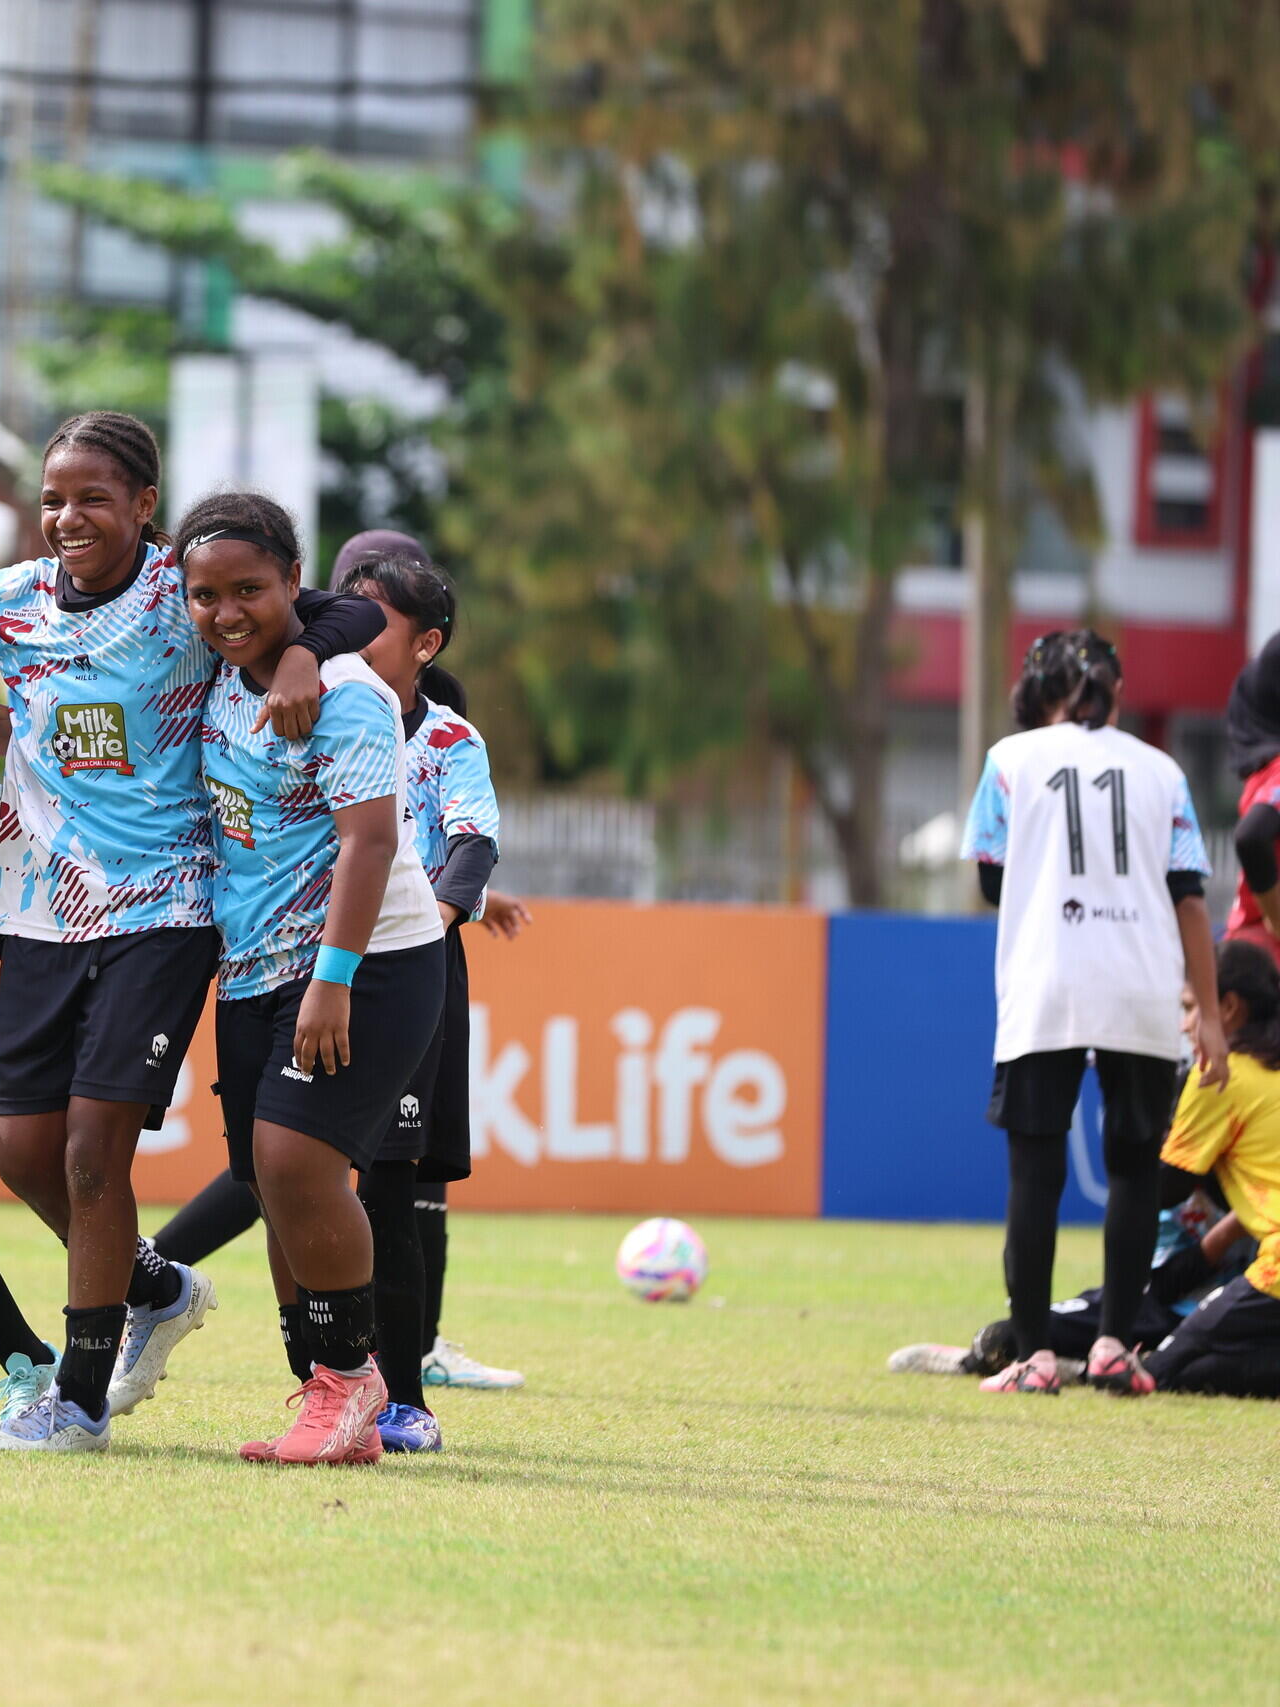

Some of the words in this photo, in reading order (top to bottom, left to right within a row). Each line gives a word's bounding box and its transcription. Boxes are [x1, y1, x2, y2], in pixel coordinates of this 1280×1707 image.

[75, 673, 98, 681] MILLS
[63, 707, 119, 735] Milk
[75, 732, 124, 759] Life
[69, 761, 89, 769] SOCCER
[89, 759, 122, 768] CHALLENGE
[210, 781, 249, 810] Milk
[1046, 766, 1129, 876] 11
[398, 1120, 422, 1128] MILLS
[71, 1336, 112, 1350] MILLS
